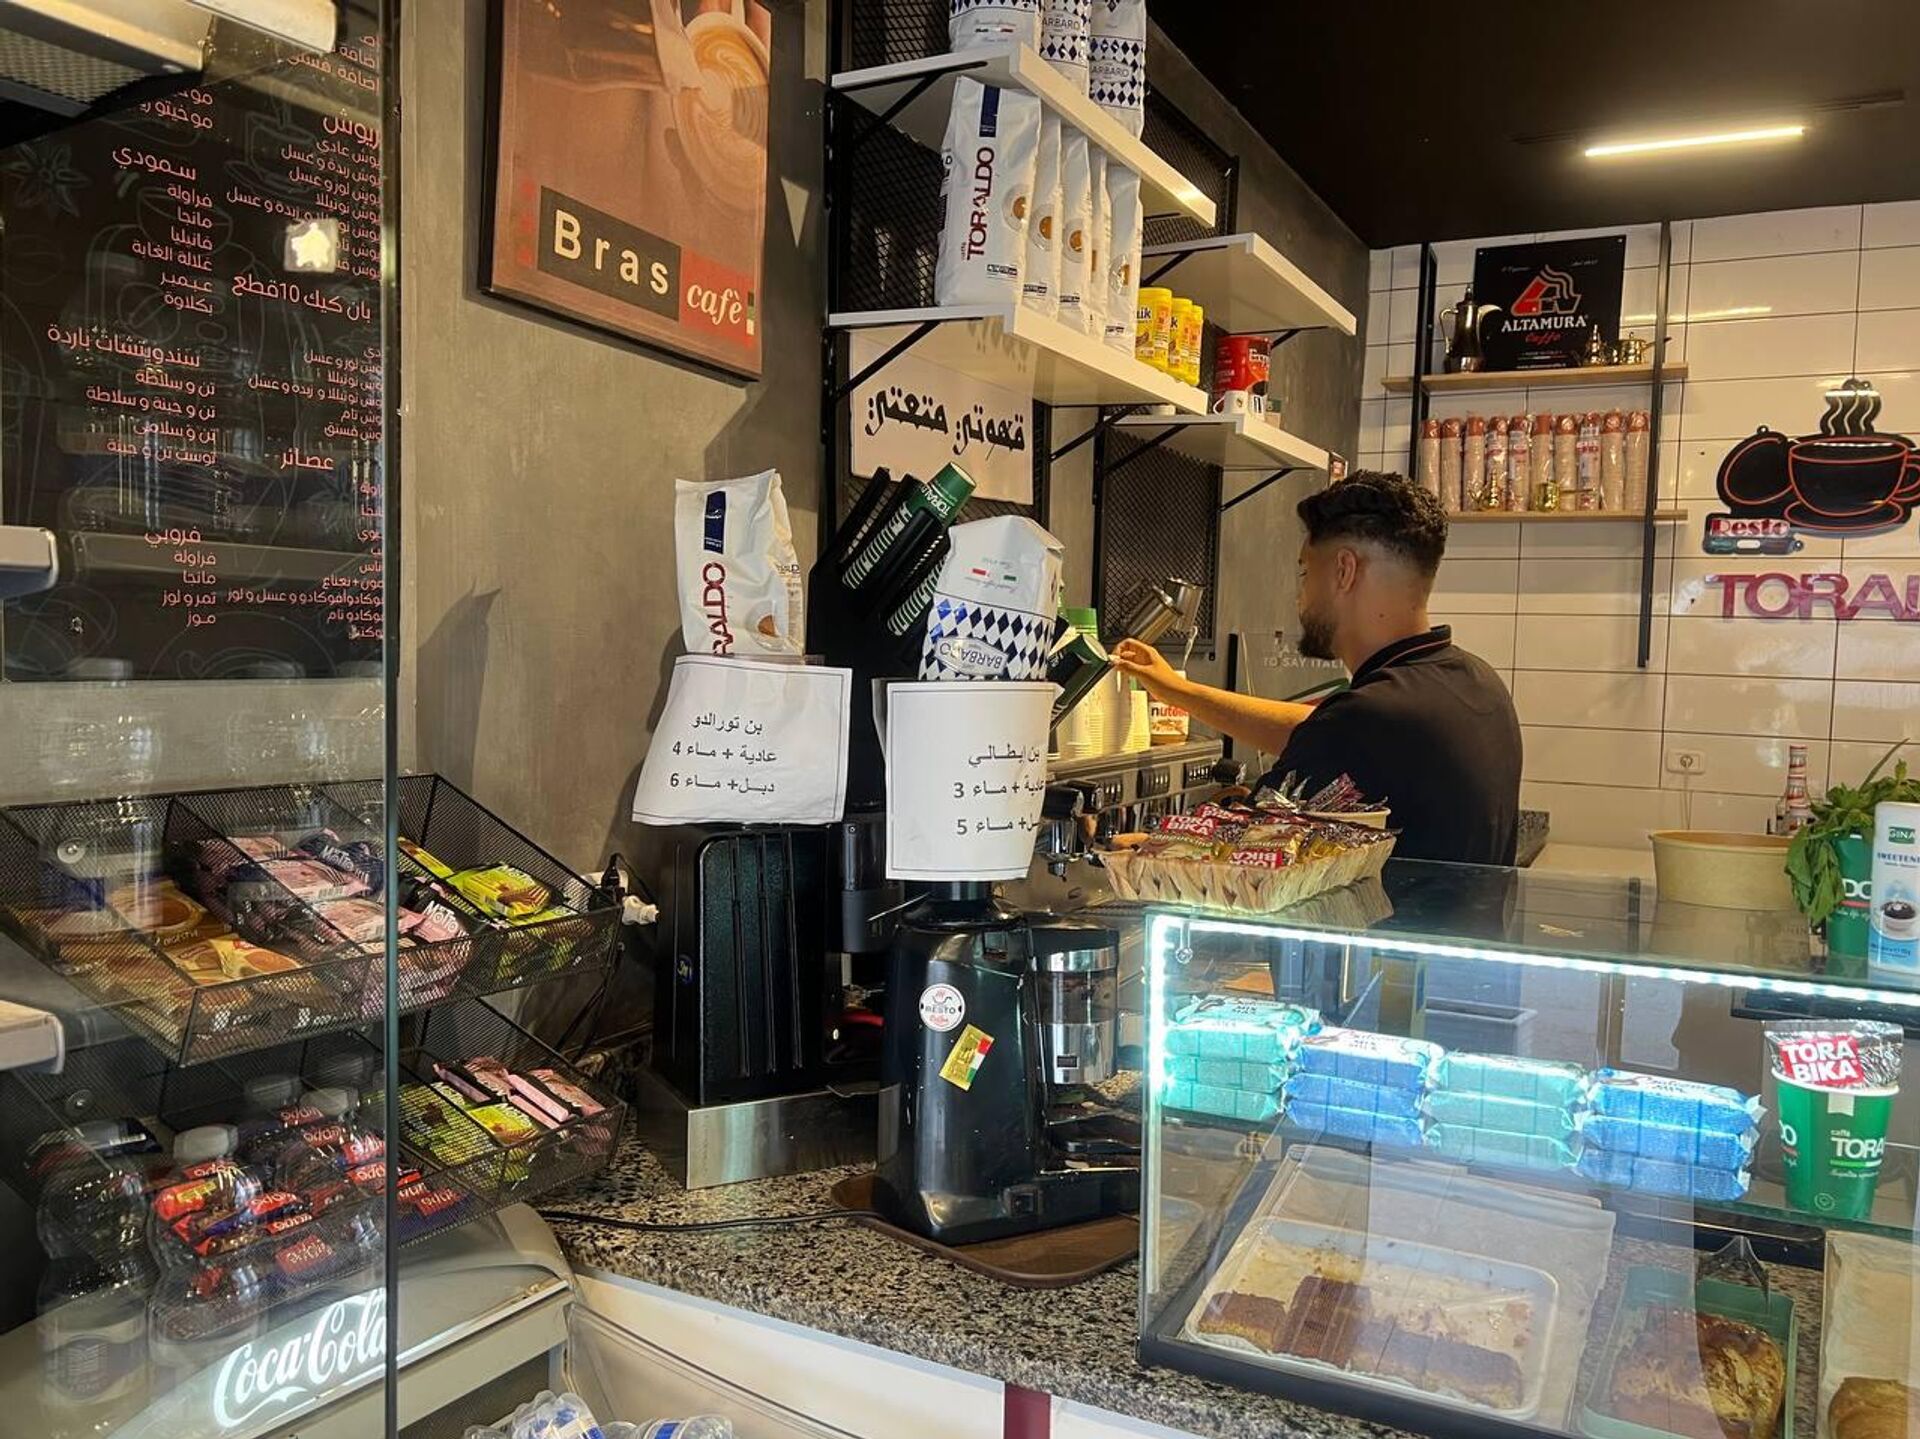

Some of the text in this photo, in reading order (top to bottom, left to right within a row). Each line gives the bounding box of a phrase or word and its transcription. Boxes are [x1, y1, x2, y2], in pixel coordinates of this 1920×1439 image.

[1042, 18, 1080, 30] ARBARO
[1090, 65, 1129, 78] ARBARO
[323, 107, 382, 148] ريوش
[112, 147, 196, 180] سمودي
[281, 143, 314, 166] عسل
[289, 166, 322, 188] عسل
[166, 183, 213, 209] فراولة
[226, 186, 261, 207] عسل
[177, 205, 213, 229] مانجا
[131, 239, 173, 261] الغابة
[554, 210, 669, 295] Bras
[164, 290, 213, 317] بكلاوة
[303, 289, 343, 313] كيك
[346, 301, 371, 324] بان
[1501, 316, 1586, 332] ALTAMURA
[47, 323, 200, 367] سندويتشات باردة
[303, 348, 333, 365] عسل
[247, 372, 280, 390] عسل
[86, 386, 137, 407] سلاطة
[865, 386, 1024, 461] قهوتي متعتي
[280, 447, 334, 470] عصائر
[174, 549, 216, 568] فراولة
[183, 569, 216, 587] مانجا
[183, 593, 193, 607] و
[256, 588, 287, 603] عسل
[186, 611, 216, 628] موز
[702, 562, 735, 657] RALDO
[691, 712, 763, 735] بن تورالدو
[672, 740, 778, 765] عادية + ماء 4
[1027, 746, 1040, 762] بن
[670, 772, 680, 788] 6
[685, 774, 721, 788] ماء
[953, 781, 965, 799] 3
[973, 780, 1007, 797] ماء
[1011, 782, 1020, 794] +
[956, 818, 968, 835] 5
[976, 816, 1014, 833] ماء
[1889, 829, 1916, 842] GINA
[1783, 1040, 1855, 1065] TORA
[1792, 1060, 1858, 1083] BIKA
[213, 1287, 386, 1428] Coca-Cola
